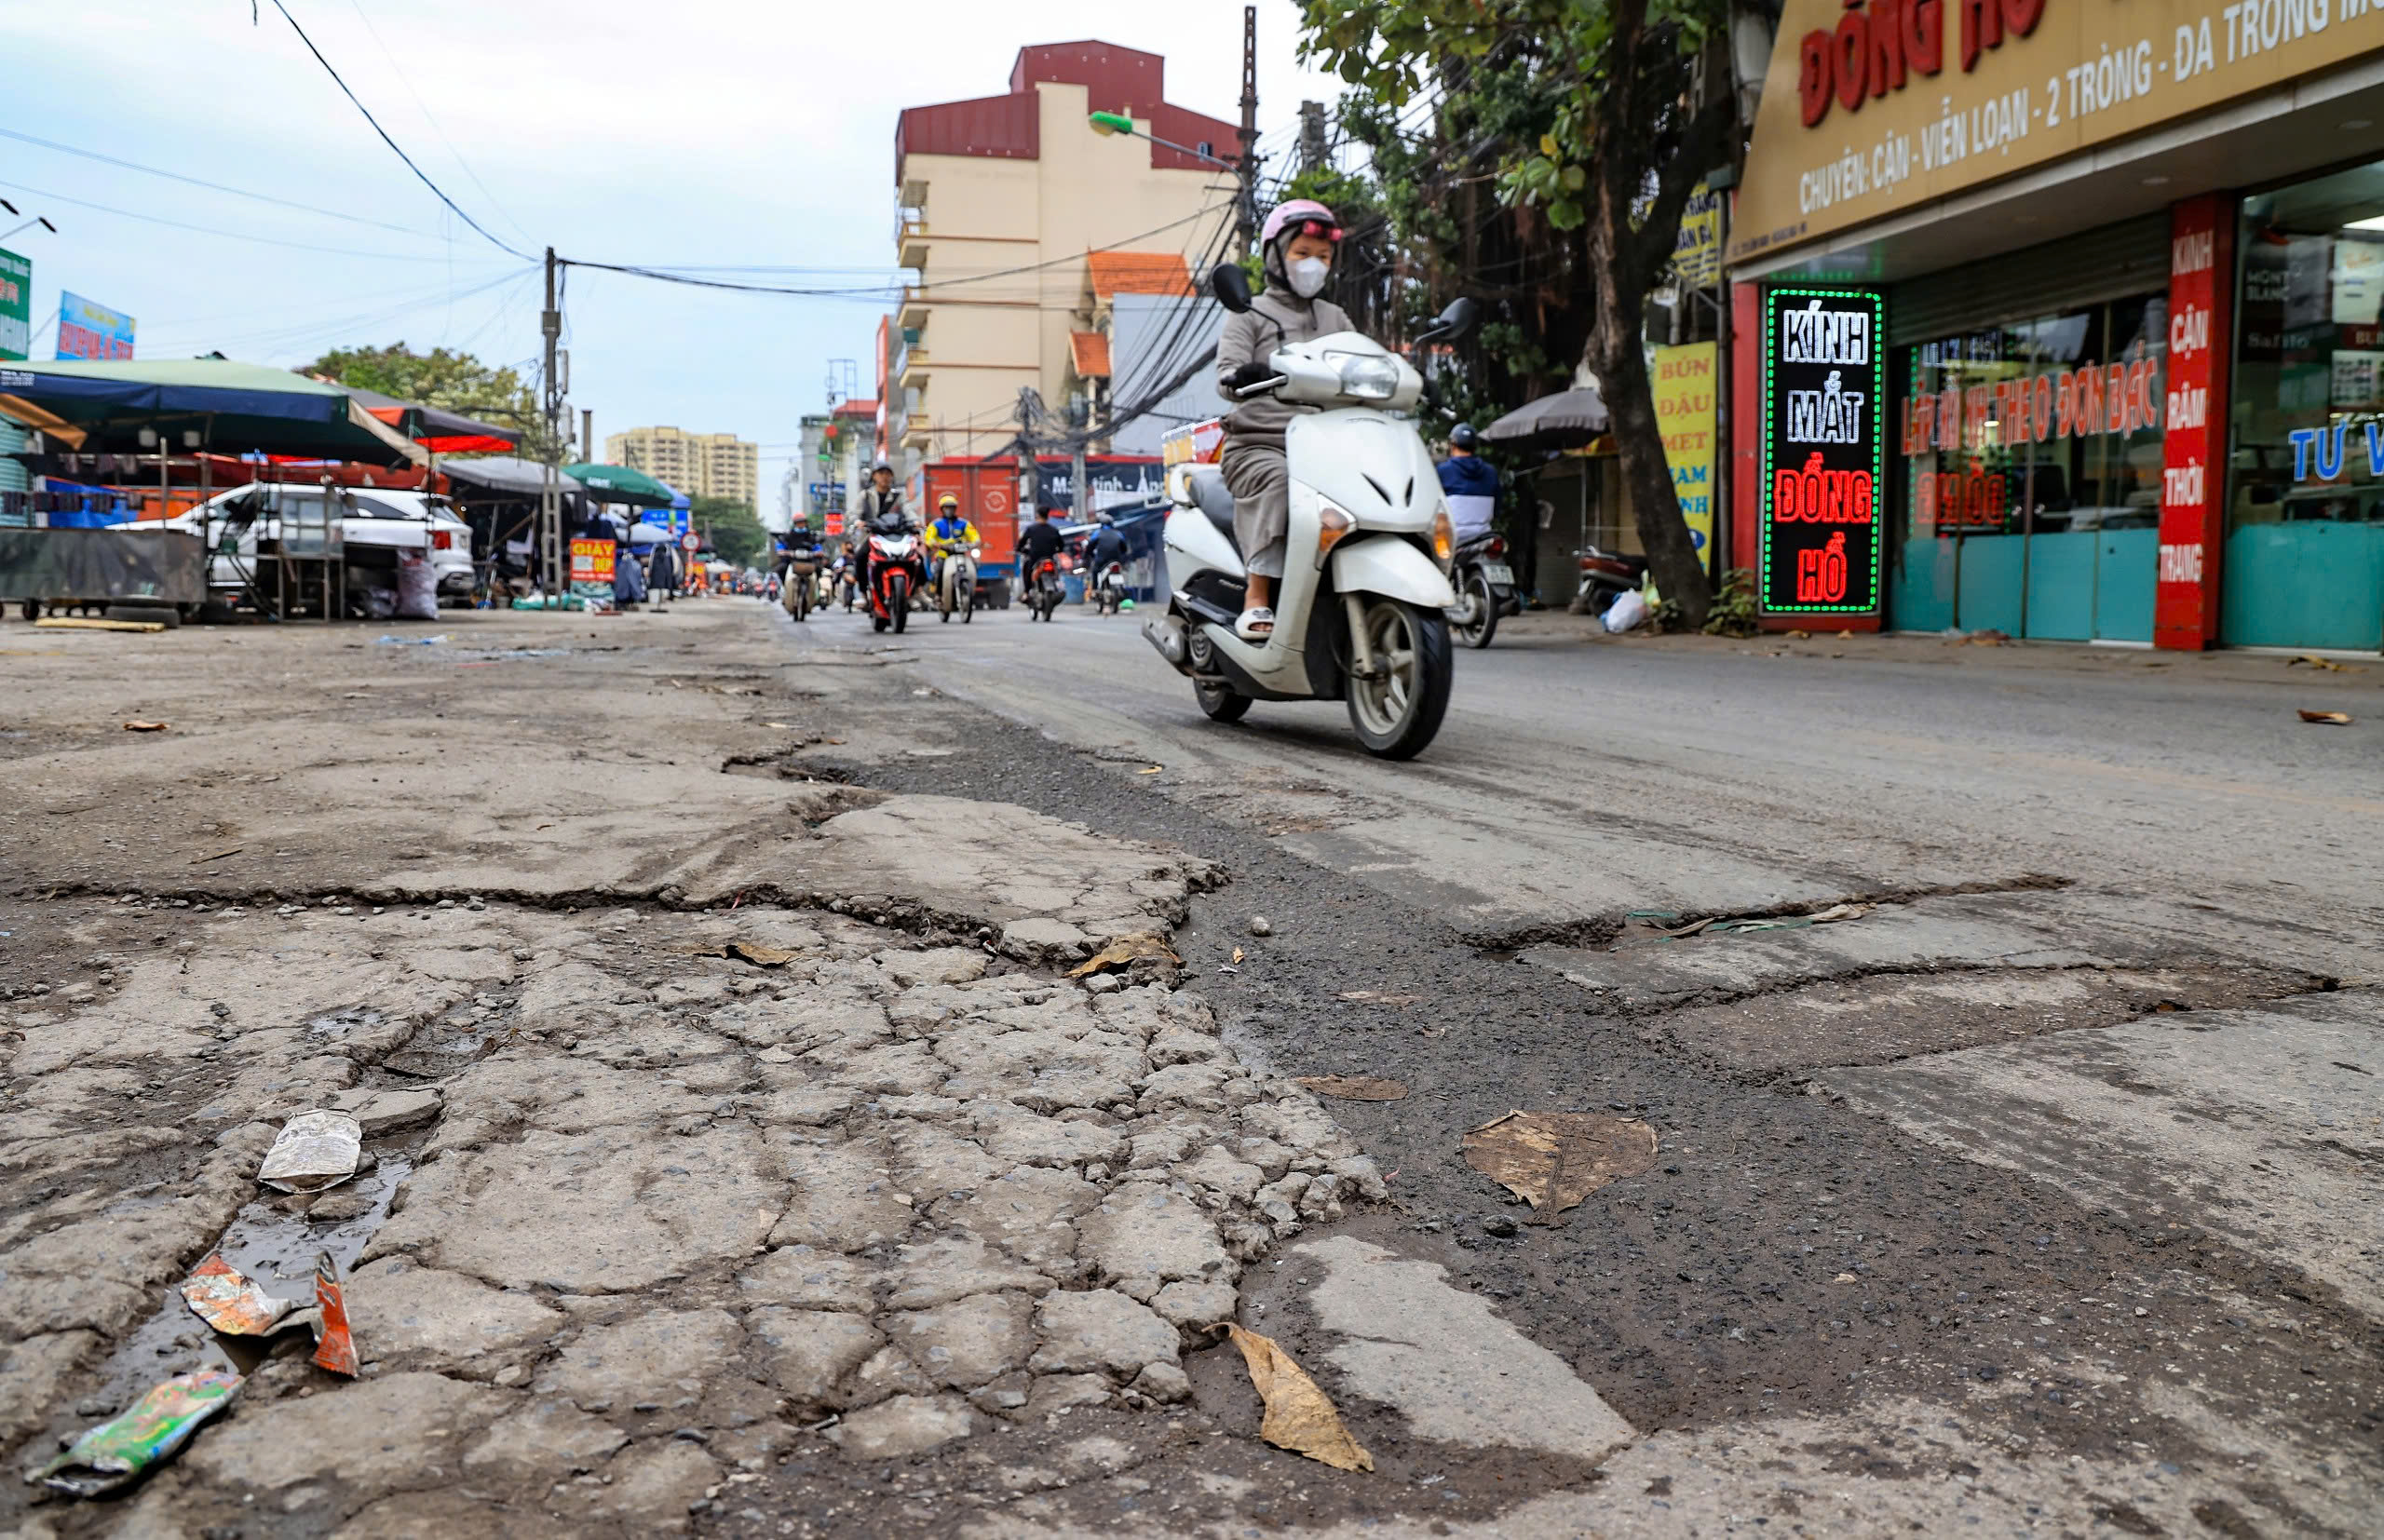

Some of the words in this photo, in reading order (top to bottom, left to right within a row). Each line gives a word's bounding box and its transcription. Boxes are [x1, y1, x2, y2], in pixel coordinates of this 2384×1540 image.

[1873, 129, 1910, 194] CẬN
[1921, 95, 1968, 171] VIỄN
[1972, 88, 2029, 155] LOẠN
[2046, 76, 2060, 127] 2
[2066, 40, 2152, 119] TRÒNG
[2174, 17, 2215, 82] ĐA
[1782, 300, 1869, 365] KÍNH
[2171, 303, 2210, 360] CẬN
[1660, 355, 1711, 380] BÚN
[1787, 371, 1864, 444] MẮT
[1669, 465, 1707, 484] AM
[2164, 456, 2204, 507] THỜI
[2288, 419, 2348, 481] TƯ
[1773, 452, 1873, 524] ĐỒNG
[1796, 531, 1848, 602] HỒ
